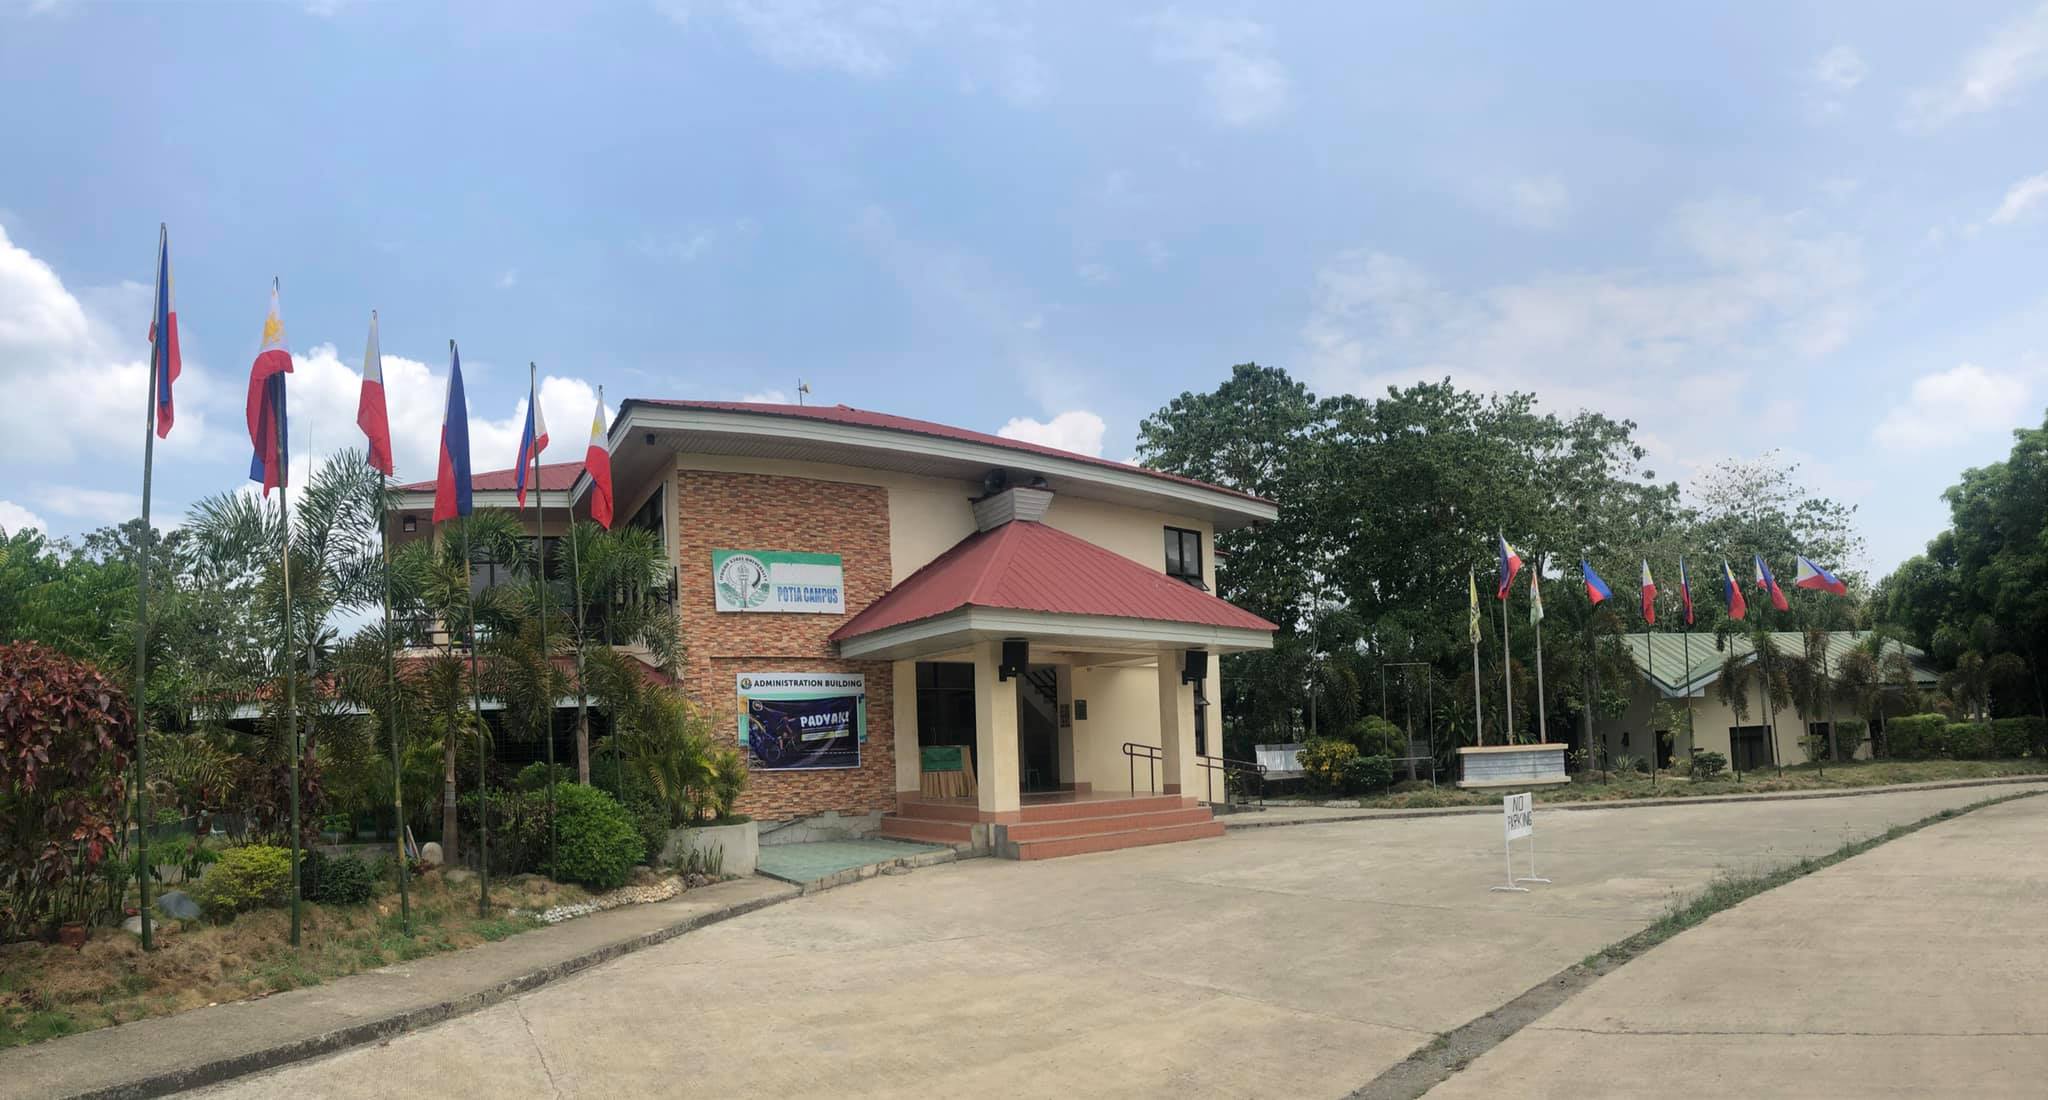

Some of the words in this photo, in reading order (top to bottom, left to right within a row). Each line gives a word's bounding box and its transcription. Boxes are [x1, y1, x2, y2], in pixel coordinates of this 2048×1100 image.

[777, 586, 801, 603] POTIA
[803, 587, 838, 604] CAMPUS
[754, 679, 823, 688] ADMINISTRATION
[825, 679, 862, 688] BUILDING
[1512, 795, 1524, 812] NO
